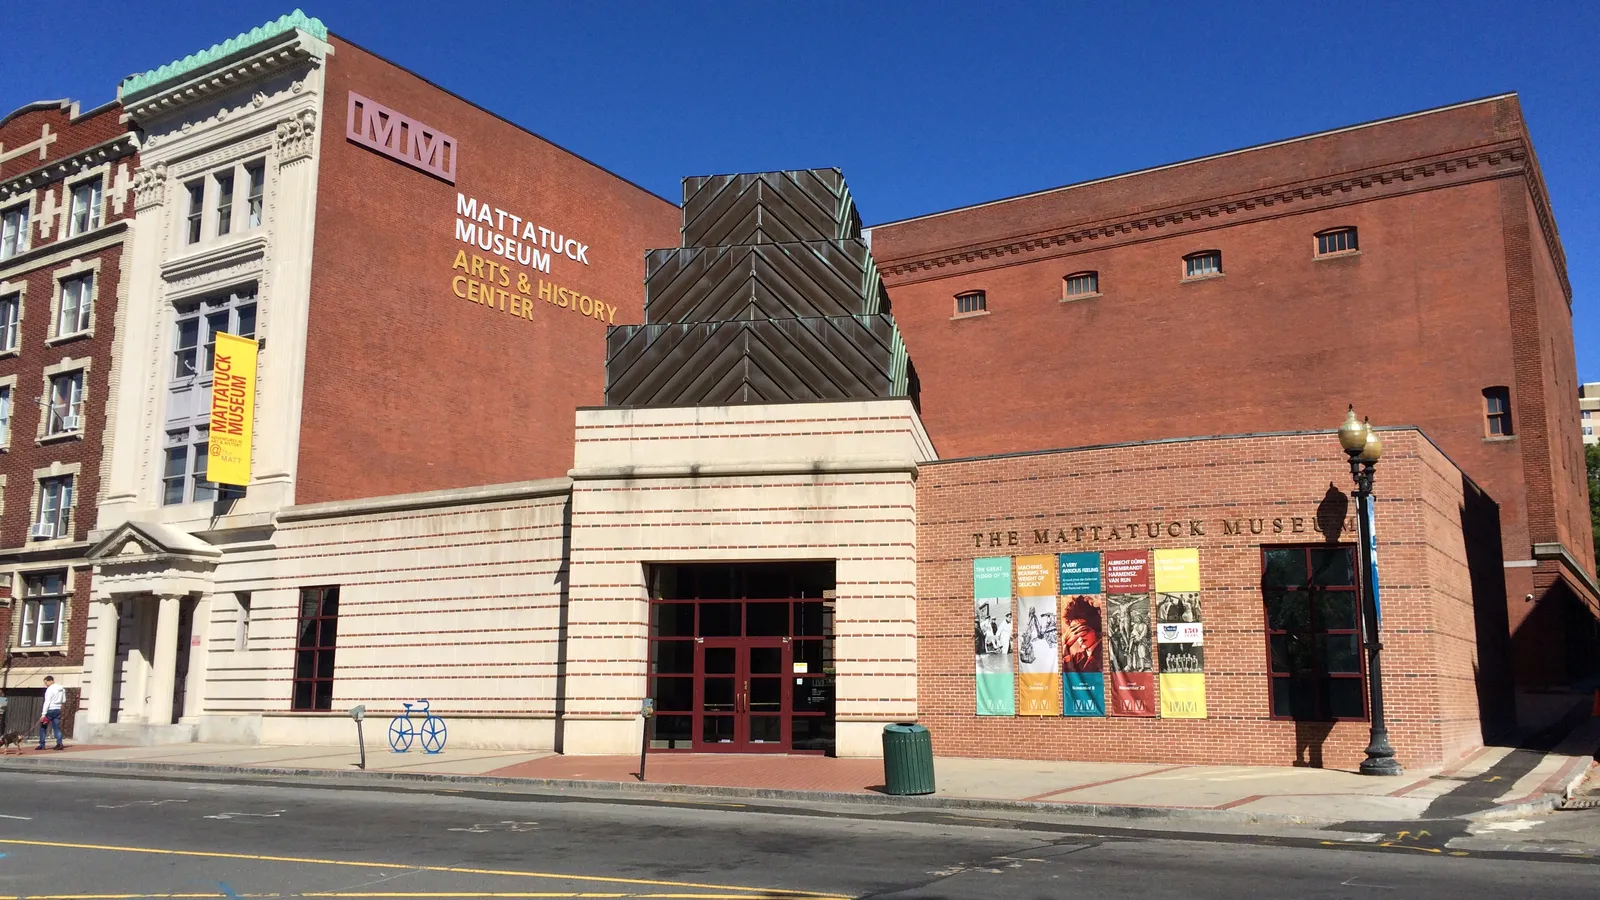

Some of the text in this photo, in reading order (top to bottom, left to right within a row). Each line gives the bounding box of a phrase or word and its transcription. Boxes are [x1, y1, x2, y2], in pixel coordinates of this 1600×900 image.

[455, 218, 551, 273] MUSEUM
[457, 193, 589, 265] MATTATUCK
[451, 275, 534, 321] CENTER
[452, 250, 617, 324] ARTS & HISTORY
[211, 353, 231, 433] MATTATUCK
[228, 375, 246, 435] MUSEUM
[210, 444, 222, 456] @
[972, 531, 1018, 547] THE
[1033, 520, 1205, 544] MATTATUCK
